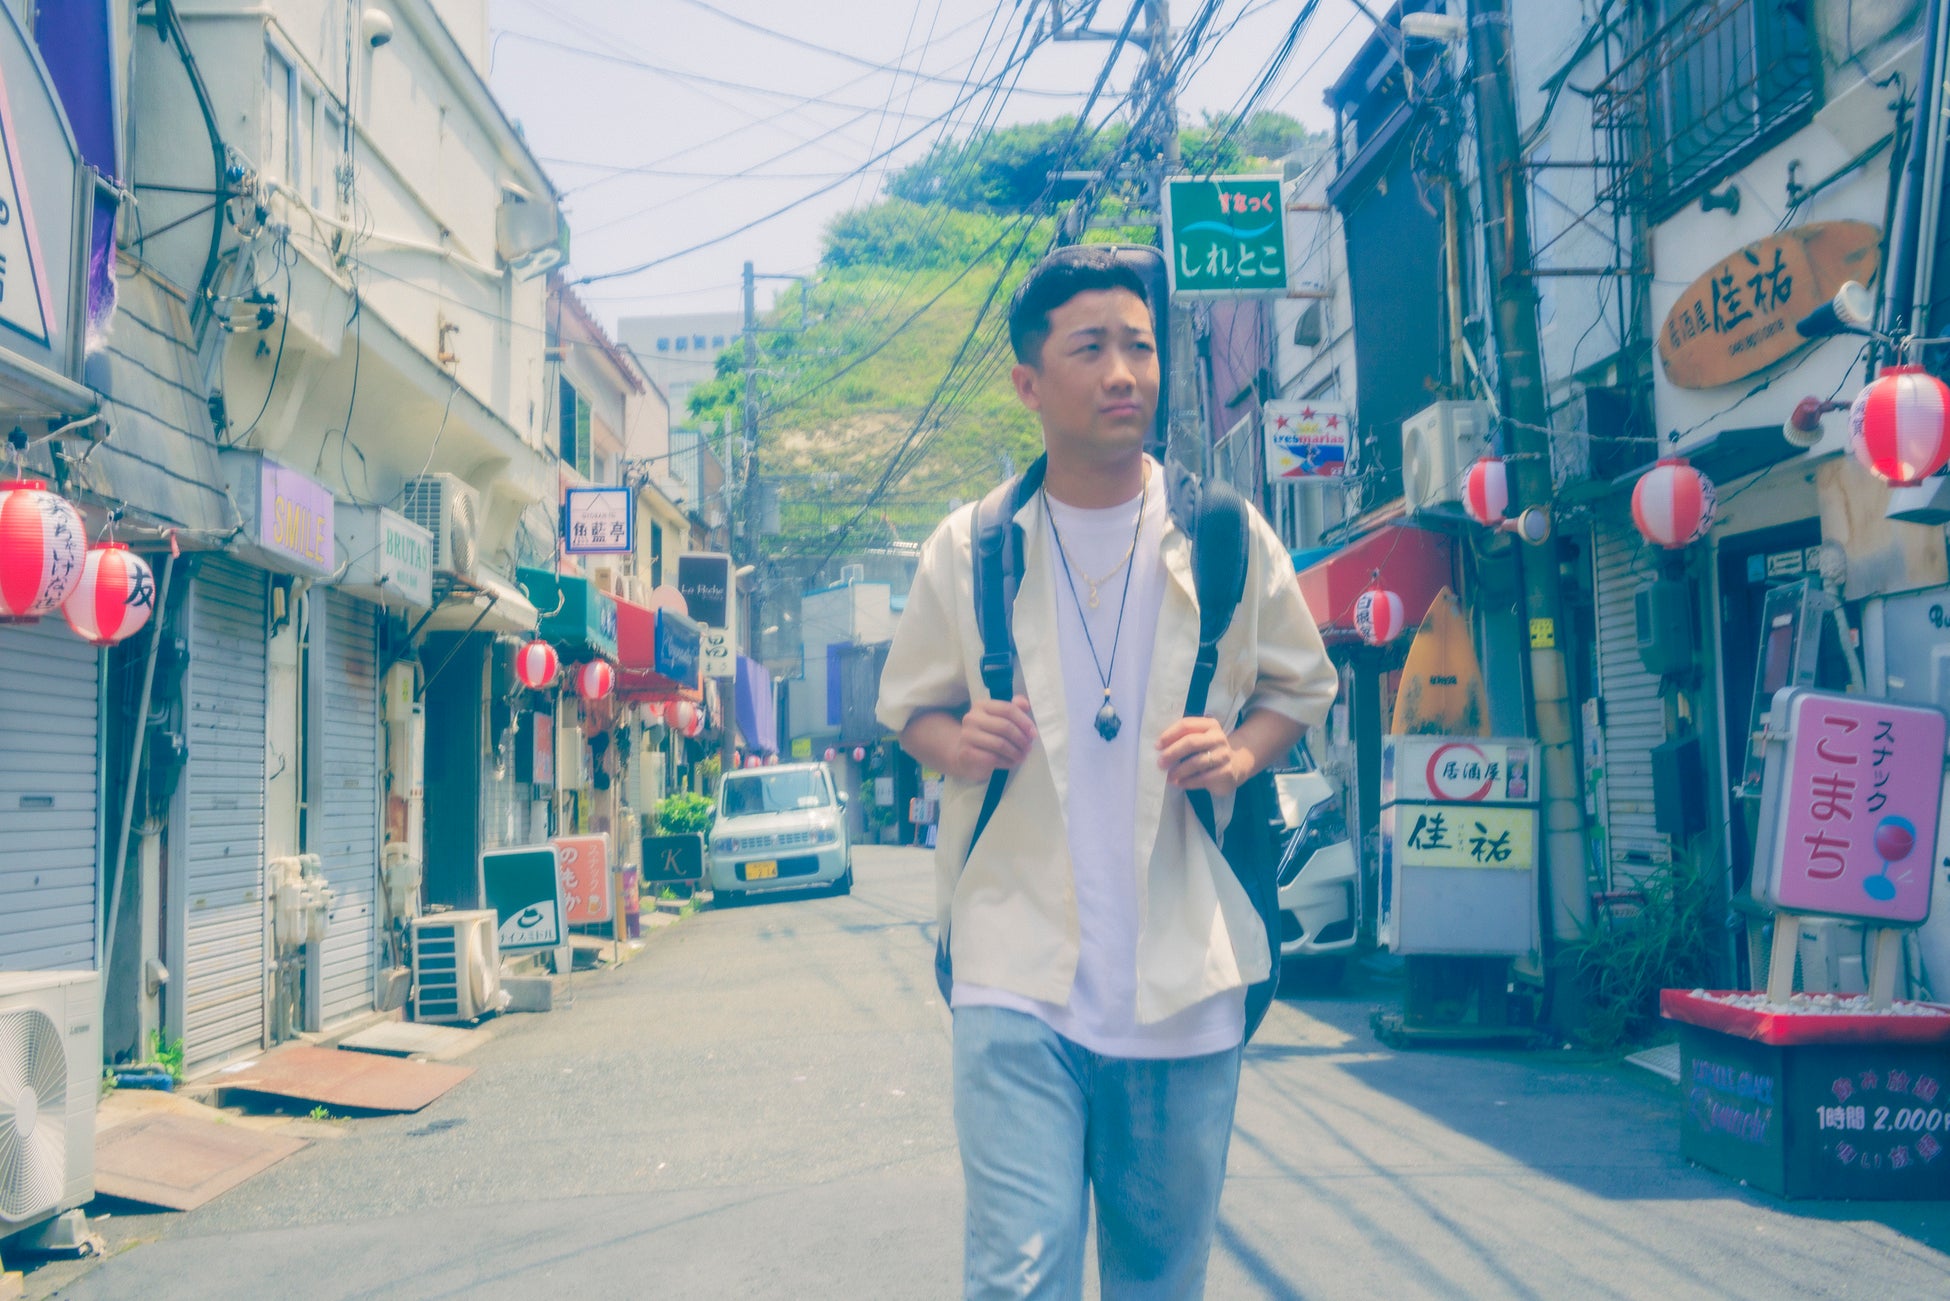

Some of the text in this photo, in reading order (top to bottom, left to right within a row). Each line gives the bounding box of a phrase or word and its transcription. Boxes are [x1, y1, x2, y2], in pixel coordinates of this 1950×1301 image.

[1218, 192, 1274, 214] すなっく
[1180, 241, 1281, 278] しれとこ
[273, 495, 325, 564] SMILE
[385, 527, 428, 571] BRUTAS
[124, 562, 154, 611] 友
[1443, 761, 1501, 781] 居酒屋
[1866, 720, 1896, 814] スナック
[1804, 715, 1860, 881] こまち
[1407, 812, 1513, 863] 佳祐
[660, 848, 687, 876] K
[1816, 1105, 1865, 1130] 1時間
